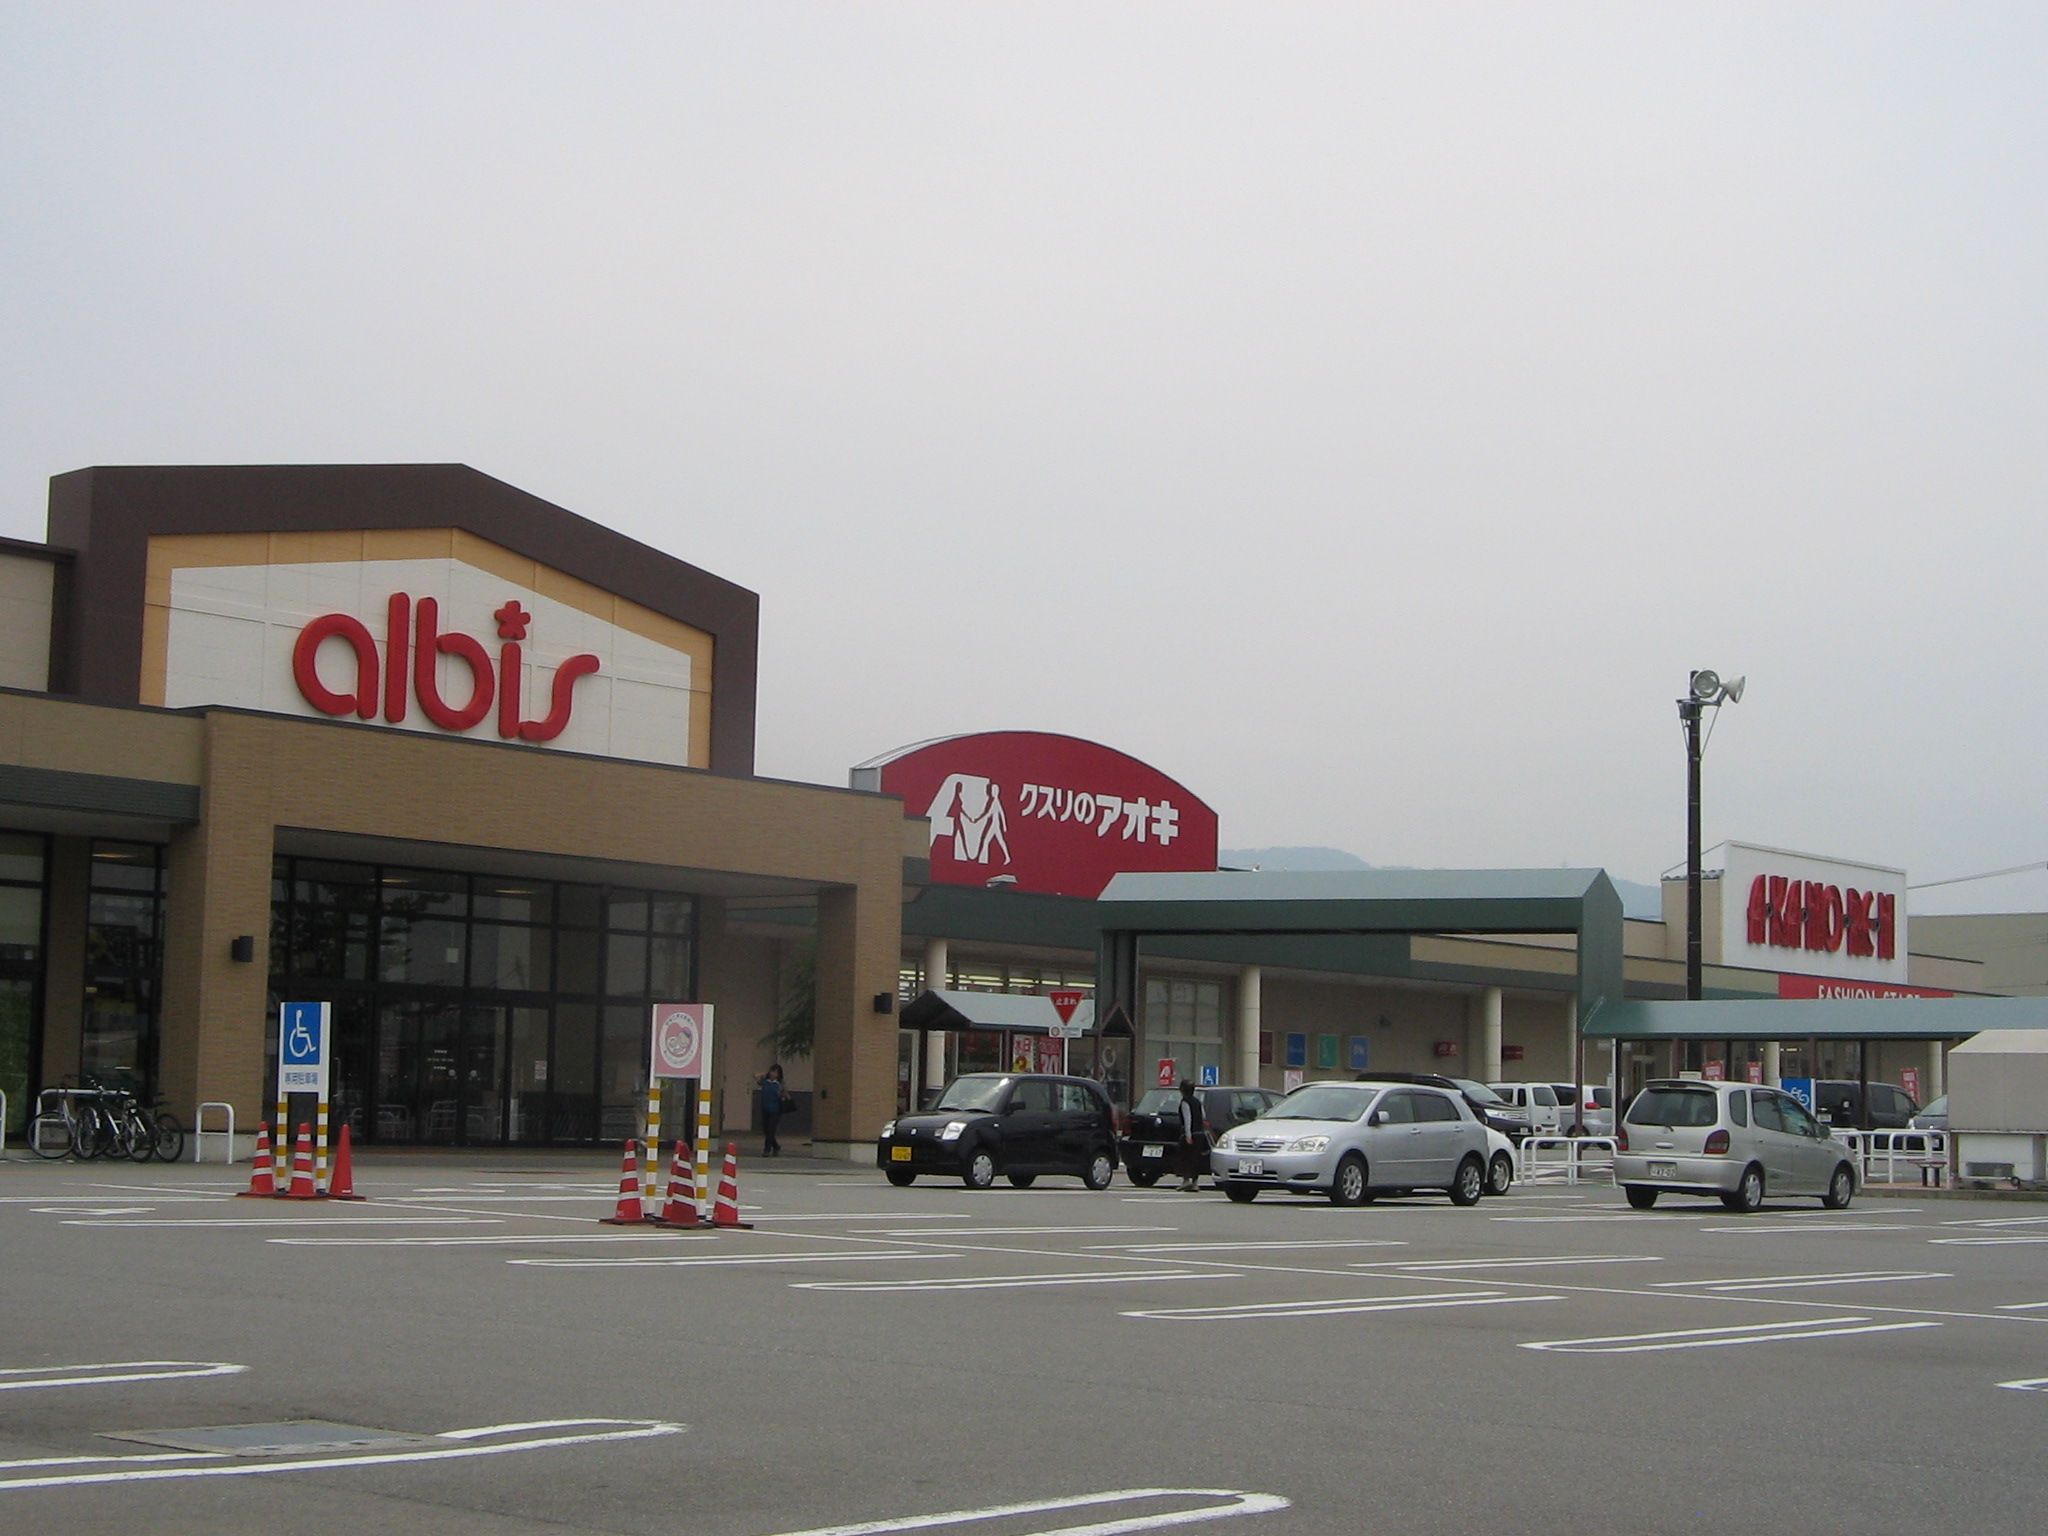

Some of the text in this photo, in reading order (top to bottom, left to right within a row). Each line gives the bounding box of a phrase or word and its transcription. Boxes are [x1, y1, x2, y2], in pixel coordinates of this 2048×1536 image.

[293, 592, 600, 741] albis
[1019, 783, 1180, 846] クスリのアオキ
[1055, 997, 1077, 1006] 止まれ
